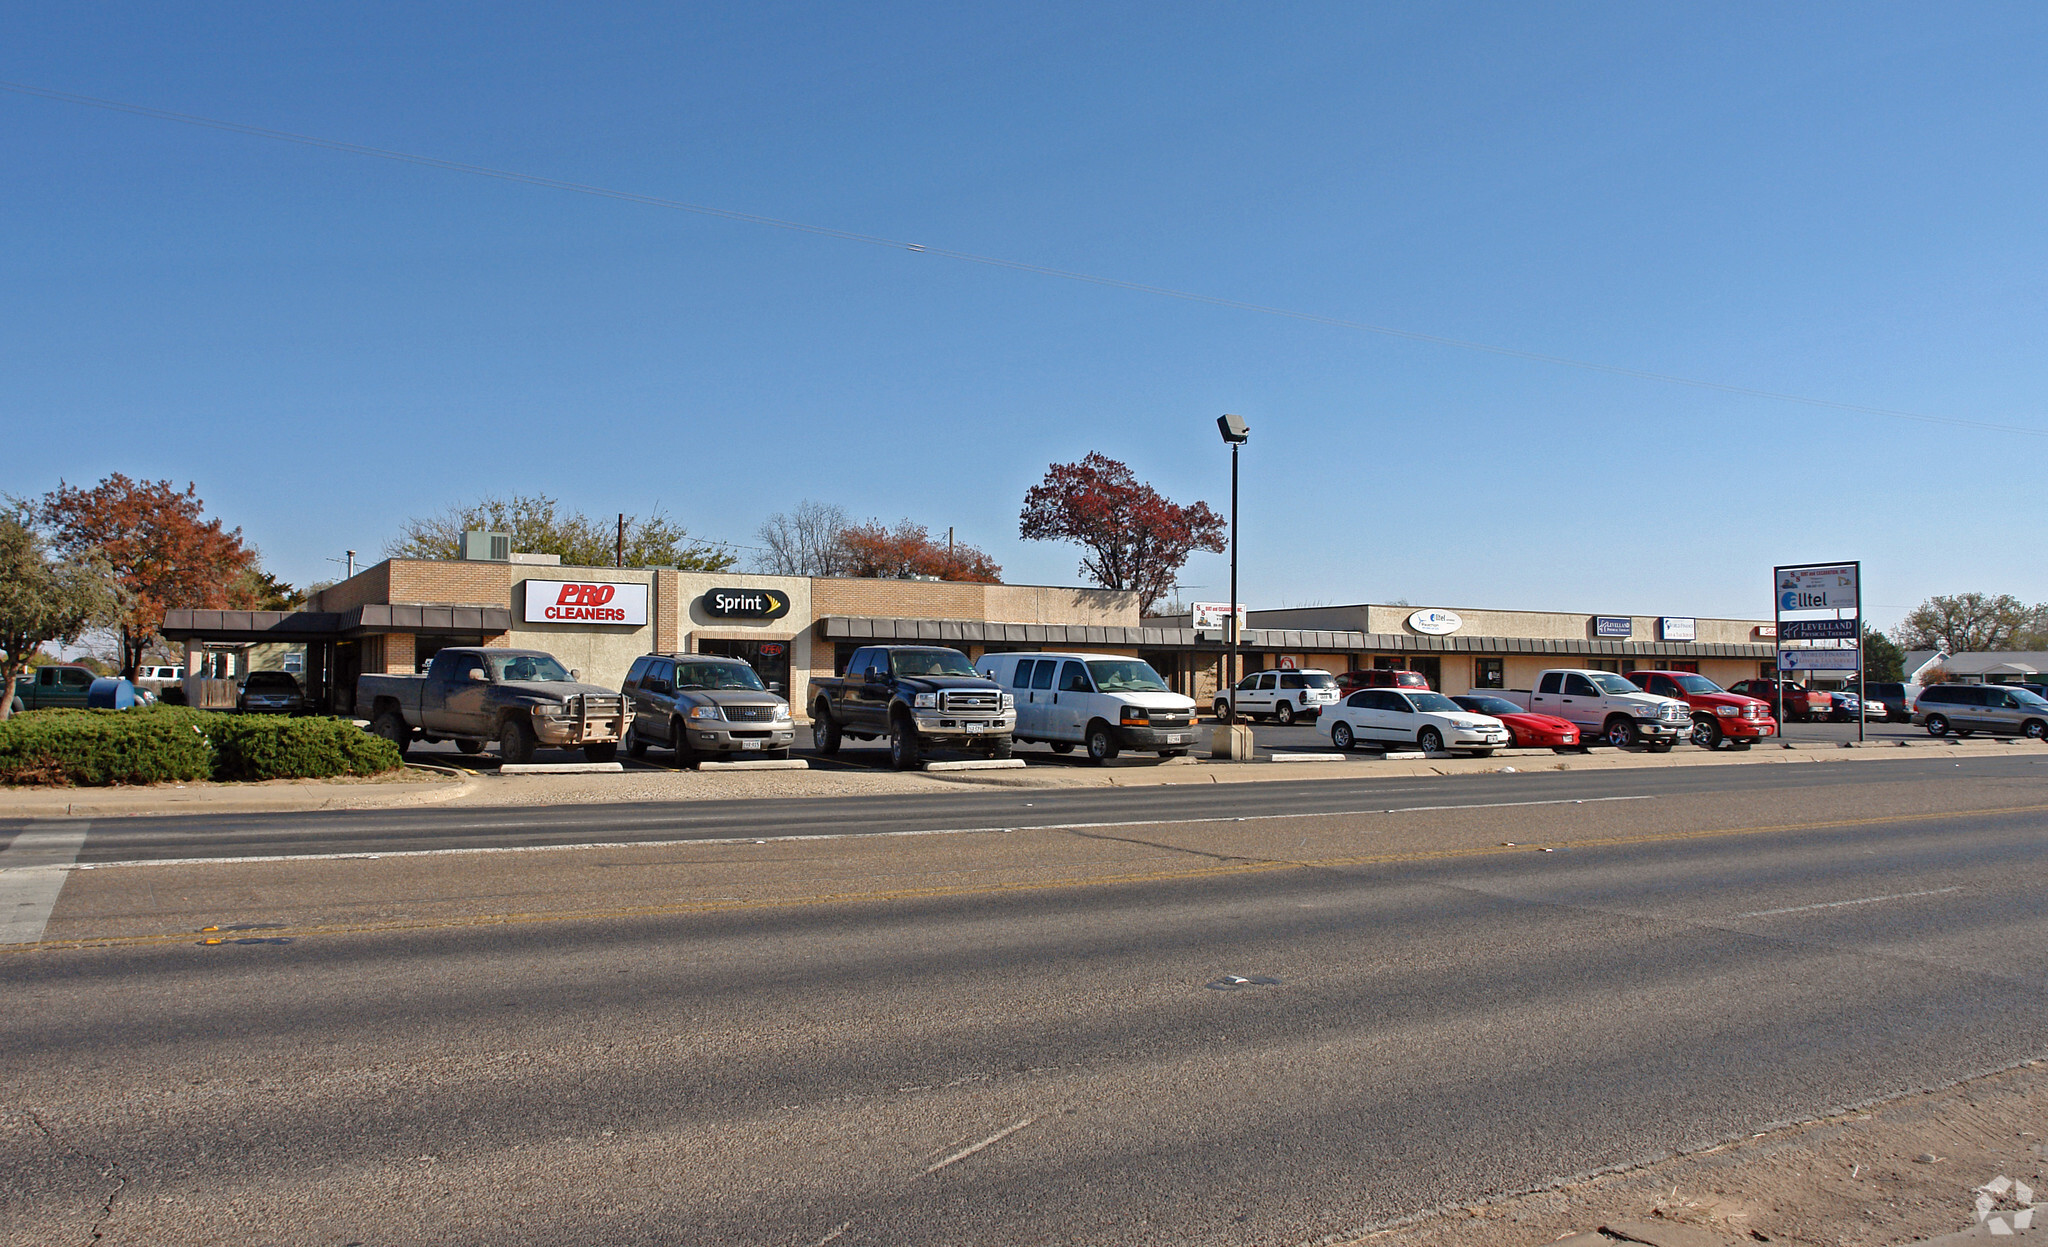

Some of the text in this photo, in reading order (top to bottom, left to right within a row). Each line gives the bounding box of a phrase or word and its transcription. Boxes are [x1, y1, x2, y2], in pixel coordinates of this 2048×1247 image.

[556, 584, 615, 606] PRO
[1789, 592, 1827, 607] alltel
[716, 594, 761, 613] Sprint
[545, 606, 625, 620] CLEANERS
[1801, 621, 1852, 630] LEVELLAND
[760, 645, 782, 654] OPEN
